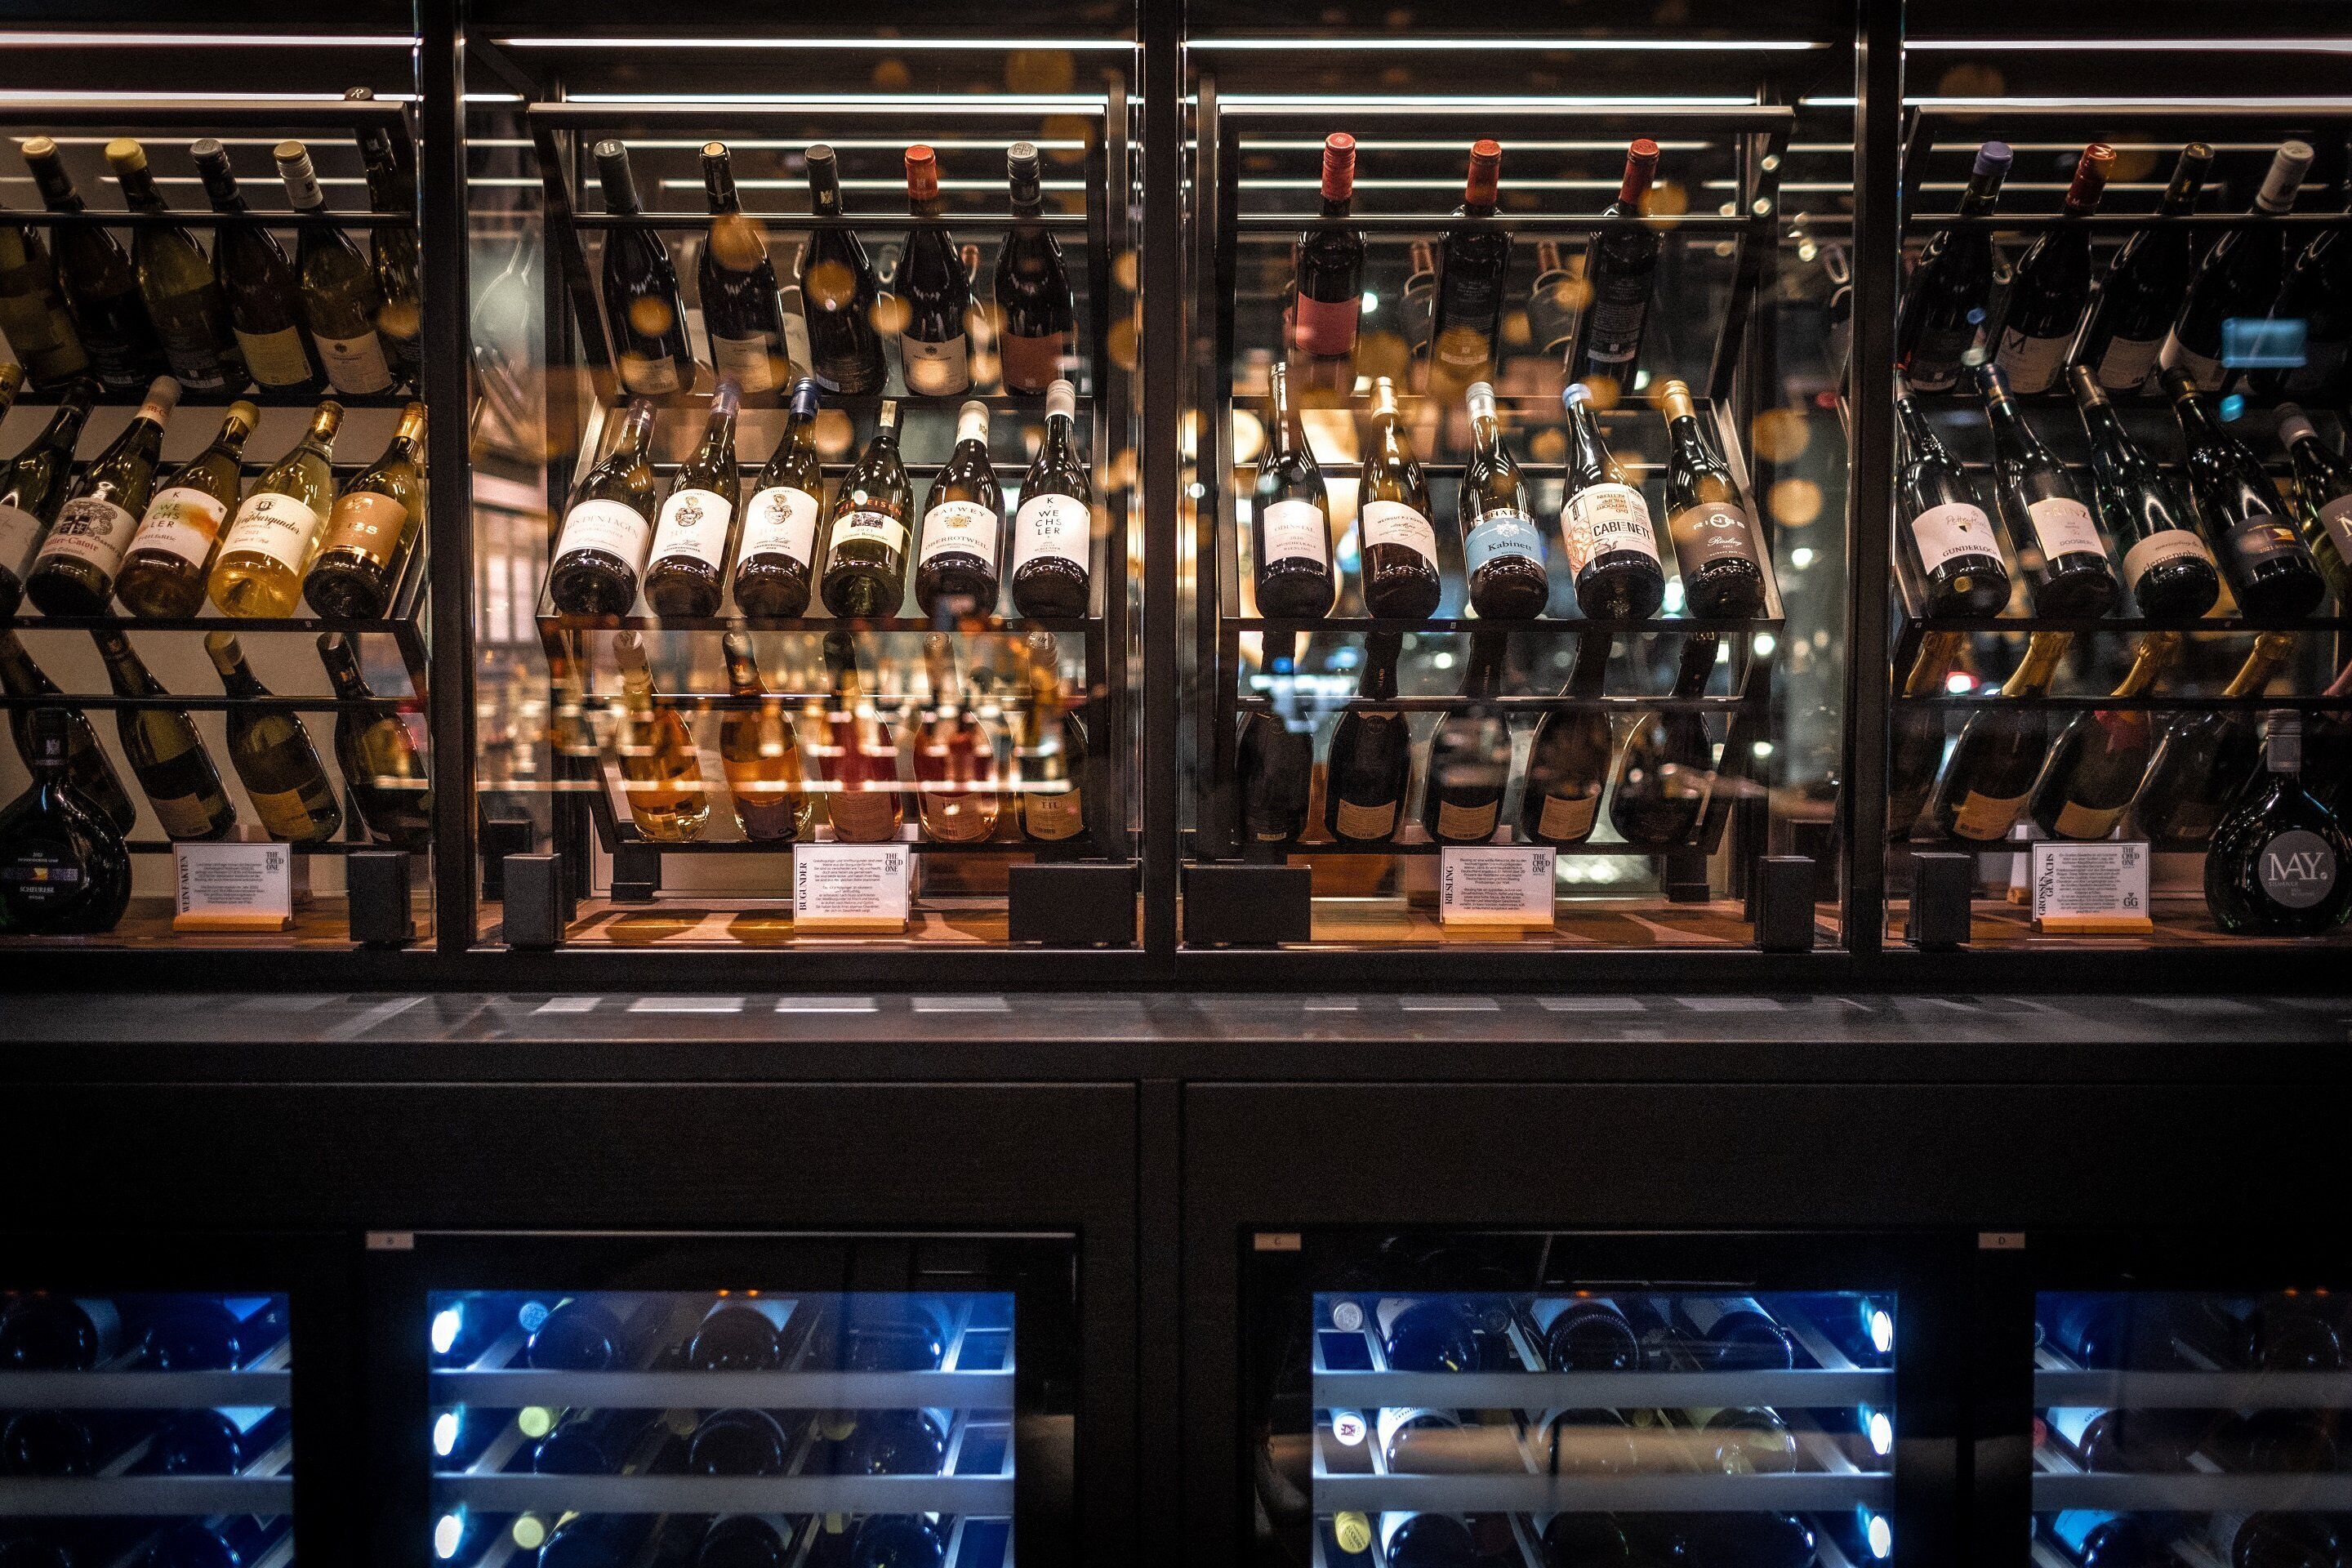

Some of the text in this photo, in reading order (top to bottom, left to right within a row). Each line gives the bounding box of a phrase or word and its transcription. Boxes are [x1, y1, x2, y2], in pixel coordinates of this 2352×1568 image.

[933, 506, 985, 518] SALWEY
[1036, 519, 1062, 527] CHS
[1037, 528, 1060, 536] LER
[925, 536, 988, 550] OBERROTWEIL
[1488, 541, 1532, 551] Kabinett
[1707, 536, 1743, 546] Riesling
[1942, 545, 1998, 557] GUNDERLOCH
[2045, 854, 2053, 897] GEWÄCHS
[1446, 866, 1454, 905] RIESLING
[2038, 875, 2047, 915] GROSSES
[2123, 898, 2138, 906] GG
